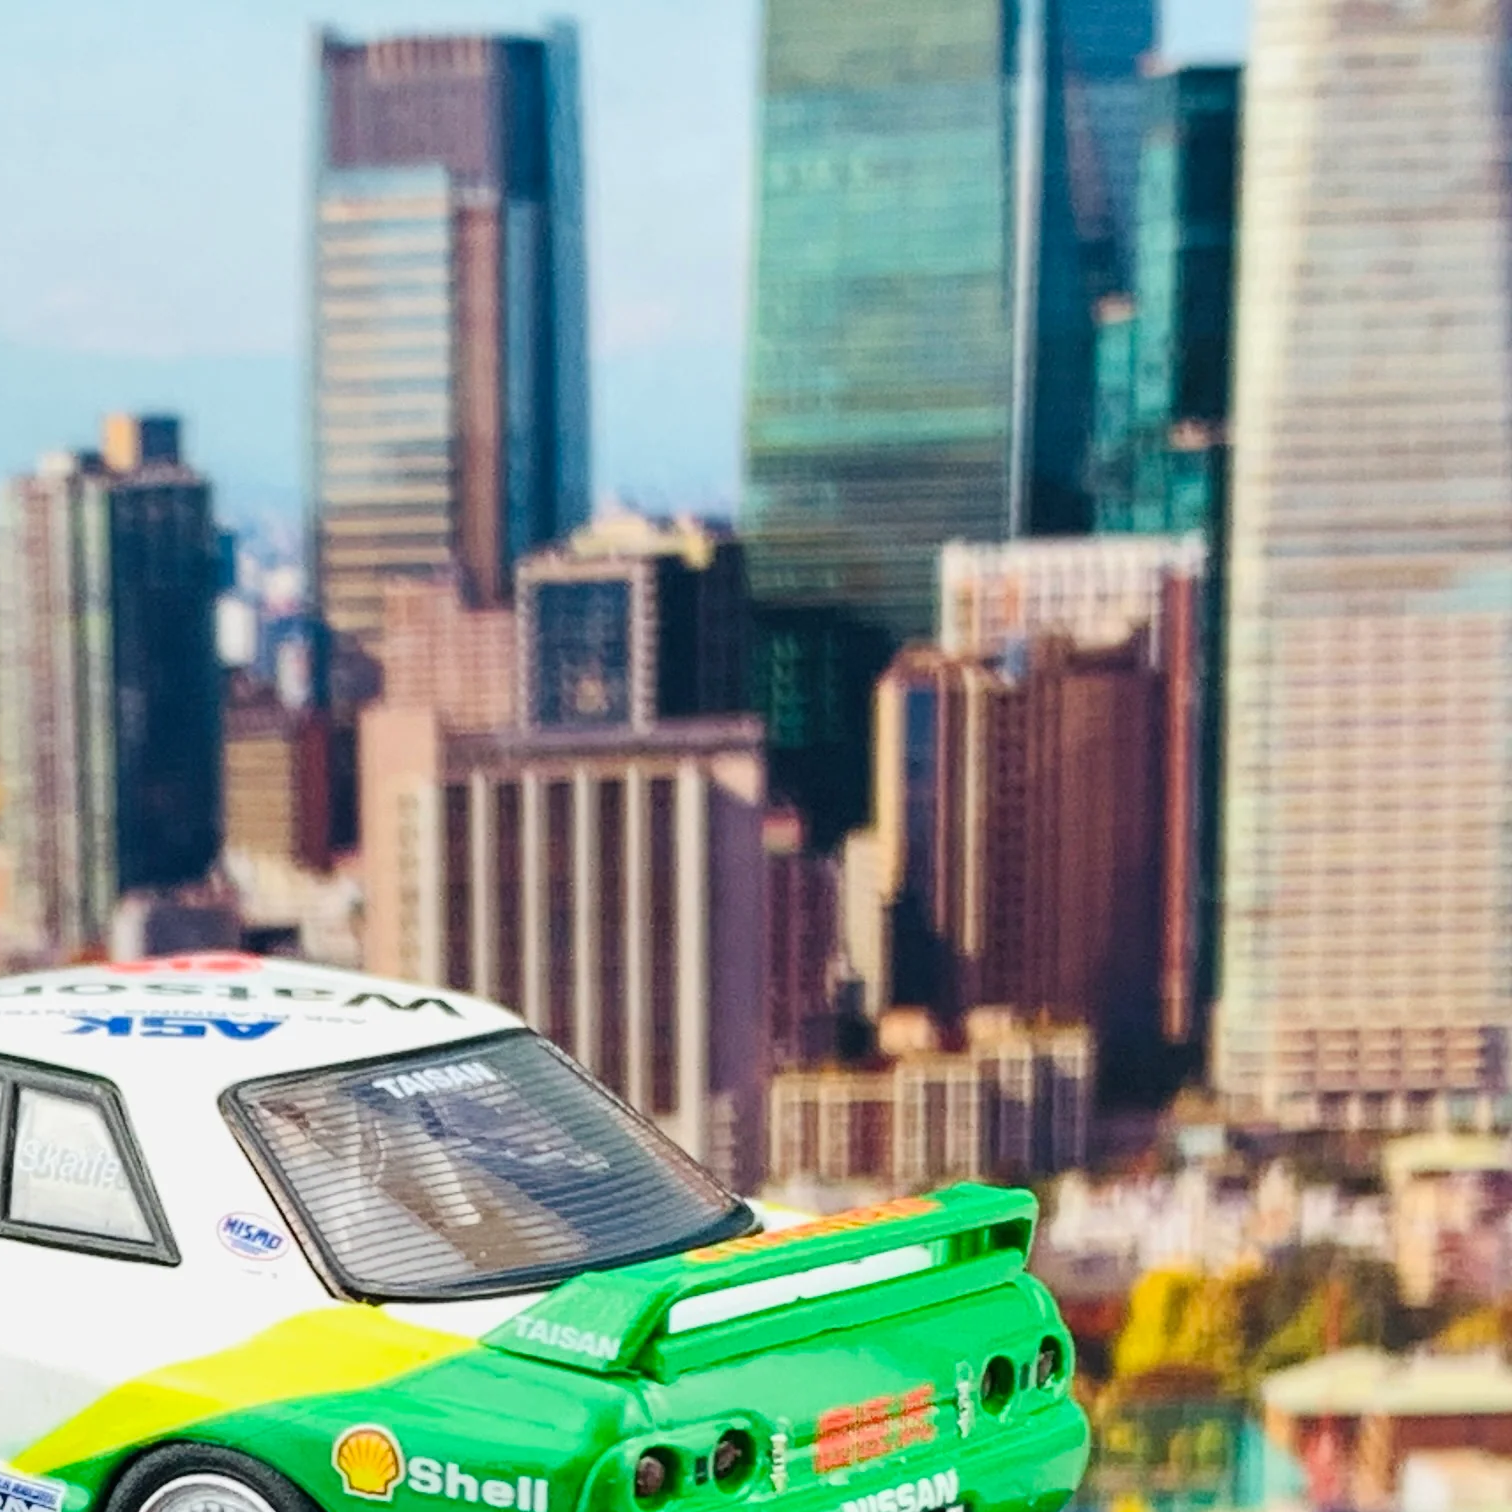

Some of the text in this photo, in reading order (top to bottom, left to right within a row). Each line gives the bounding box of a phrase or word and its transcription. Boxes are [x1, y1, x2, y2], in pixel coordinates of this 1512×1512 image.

[62, 1016, 286, 1040] ASK
[372, 1062, 497, 1099] TAISAN
[515, 1315, 621, 1361] TAISAN
